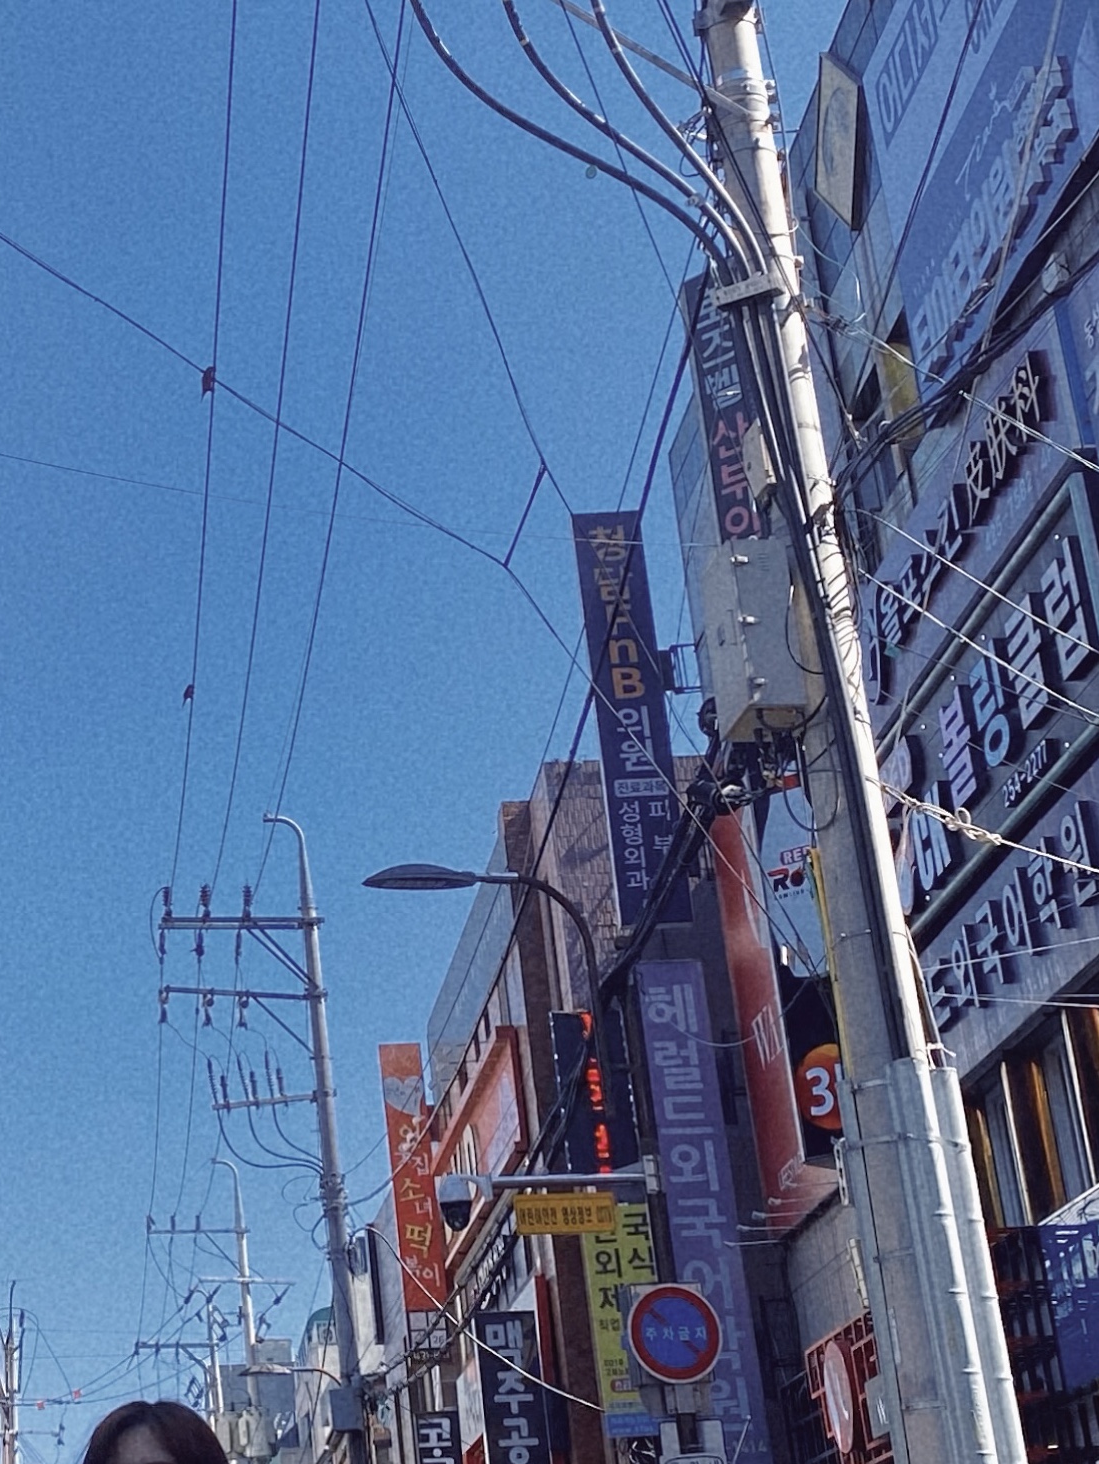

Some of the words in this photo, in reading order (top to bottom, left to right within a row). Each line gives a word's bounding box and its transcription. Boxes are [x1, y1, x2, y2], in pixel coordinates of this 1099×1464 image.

[937, 536, 1090, 811] 볼링클럽
[1002, 738, 1049, 806] 254-2277
[618, 800, 650, 891] 성형외과
[645, 1325, 707, 1341] 주차금지
